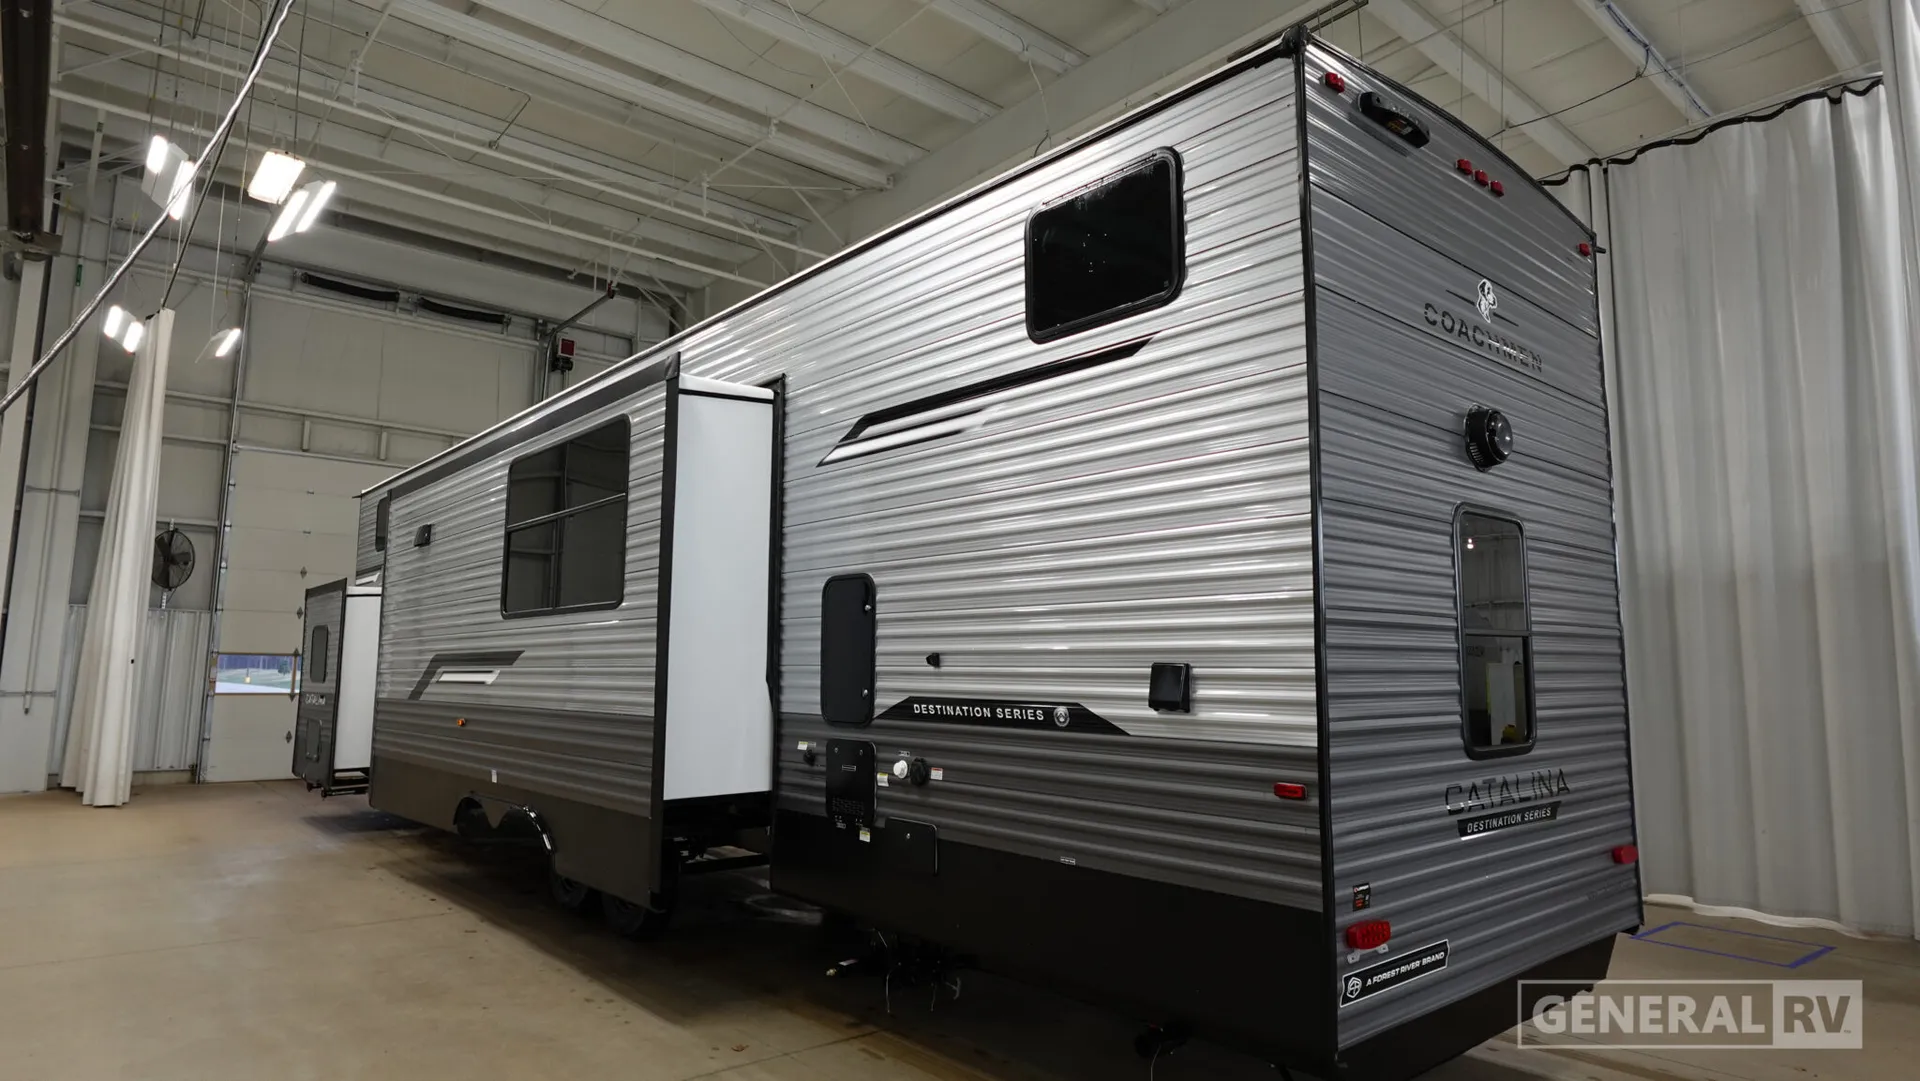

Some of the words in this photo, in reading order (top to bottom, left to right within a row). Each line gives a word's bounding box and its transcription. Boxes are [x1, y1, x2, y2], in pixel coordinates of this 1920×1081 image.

[1424, 302, 1542, 373] COACHMEN
[913, 703, 991, 718] DESTINATION
[996, 708, 1044, 721] SERIES
[1445, 768, 1571, 815] CATALINA
[1467, 814, 1522, 833] DESTINATION
[1524, 807, 1551, 821] SERIES
[1365, 978, 1373, 987] A
[1372, 967, 1401, 985] FOREST
[1421, 951, 1445, 966] BRAND
